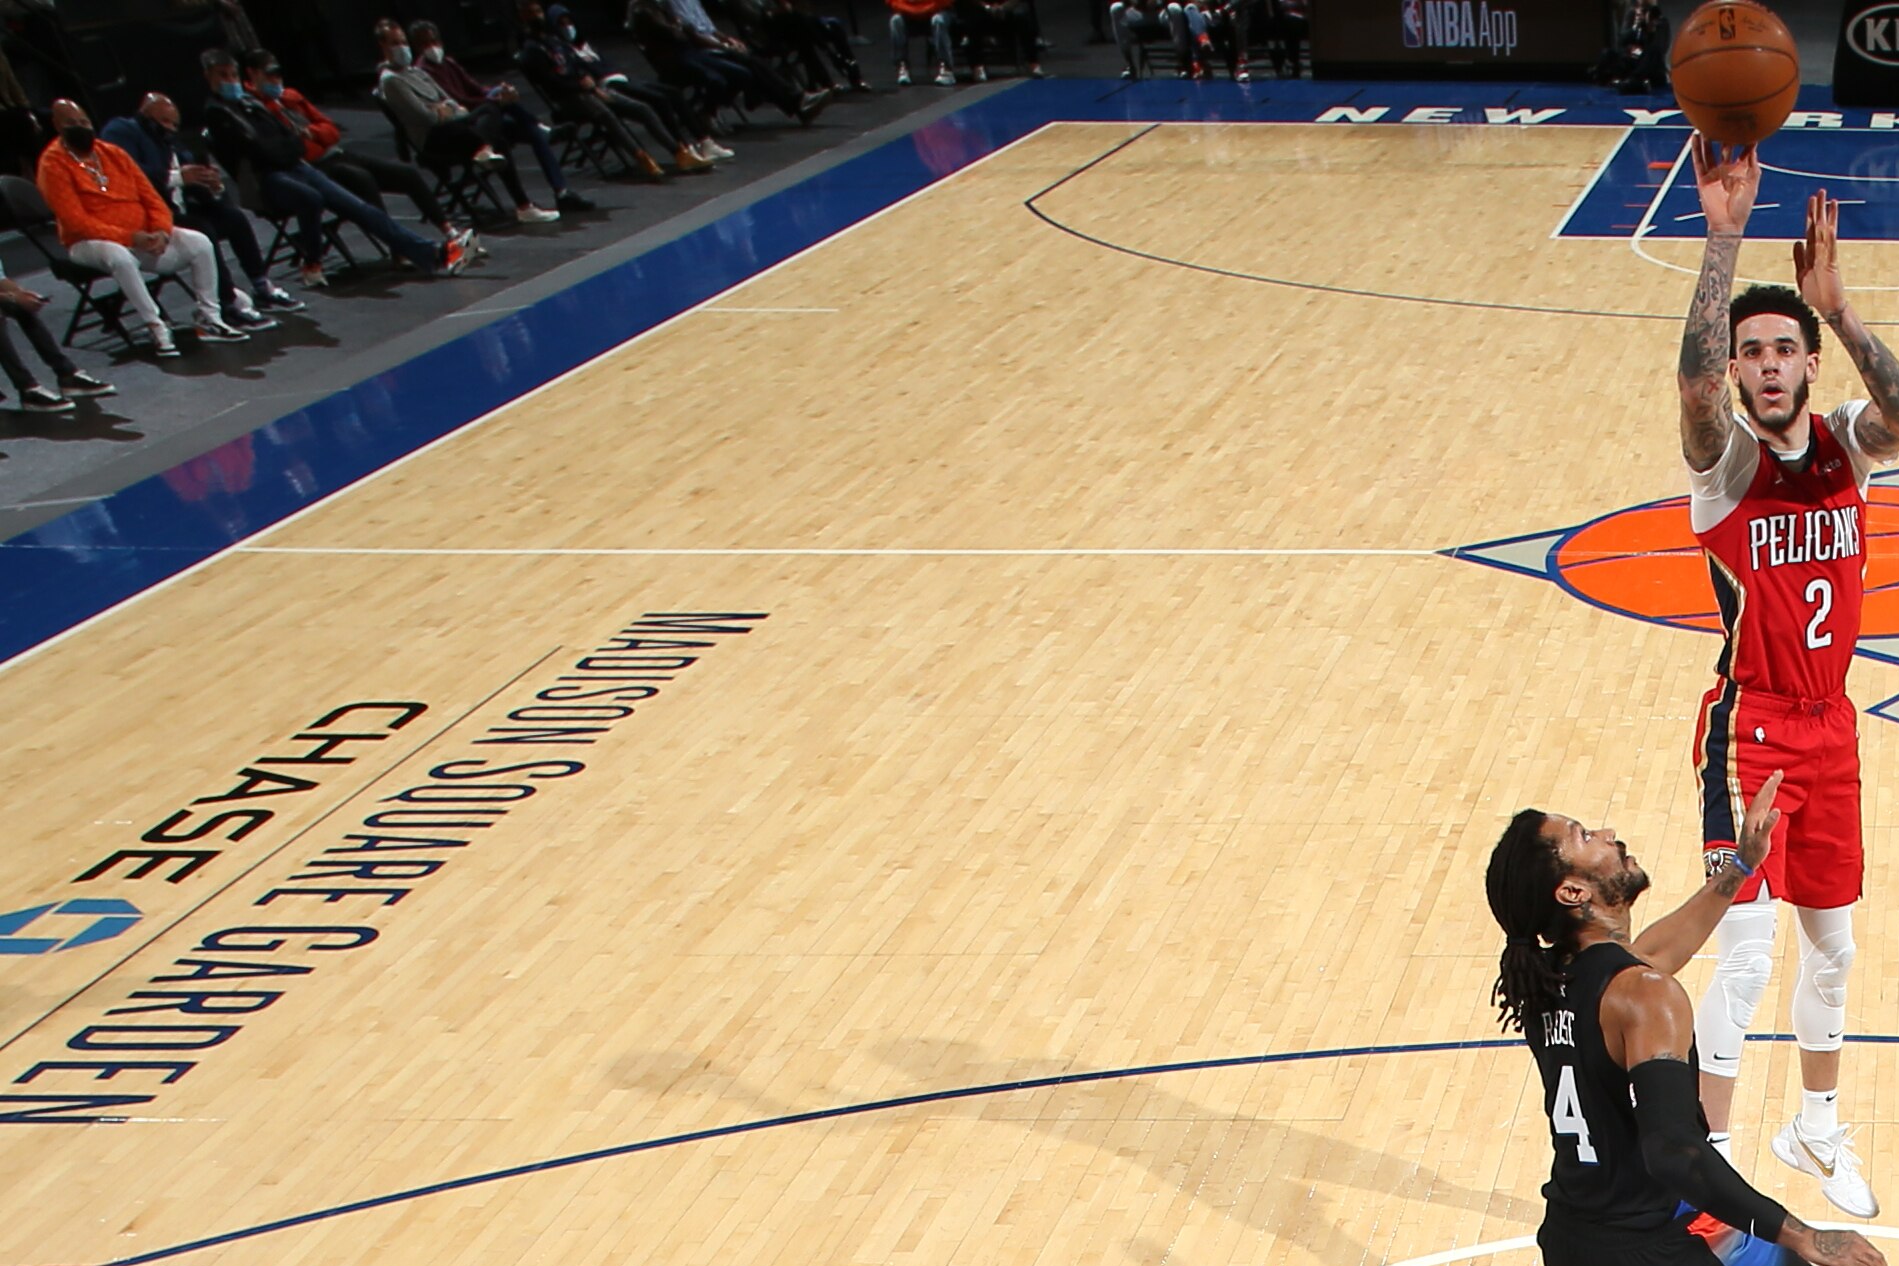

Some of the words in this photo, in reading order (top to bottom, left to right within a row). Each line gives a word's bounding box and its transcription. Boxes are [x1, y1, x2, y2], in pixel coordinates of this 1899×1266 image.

[1424, 0, 1476, 47] NBA
[1479, 1, 1517, 57] App
[1314, 106, 1567, 125] NEW
[1748, 505, 1860, 571] PELICANS
[1803, 578, 1834, 650] 2
[472, 612, 771, 746] MADISON
[70, 701, 430, 886] CHASE
[252, 758, 587, 908] SQUARE
[0, 925, 381, 1125] GARDEN
[1551, 1065, 1599, 1166] 4
